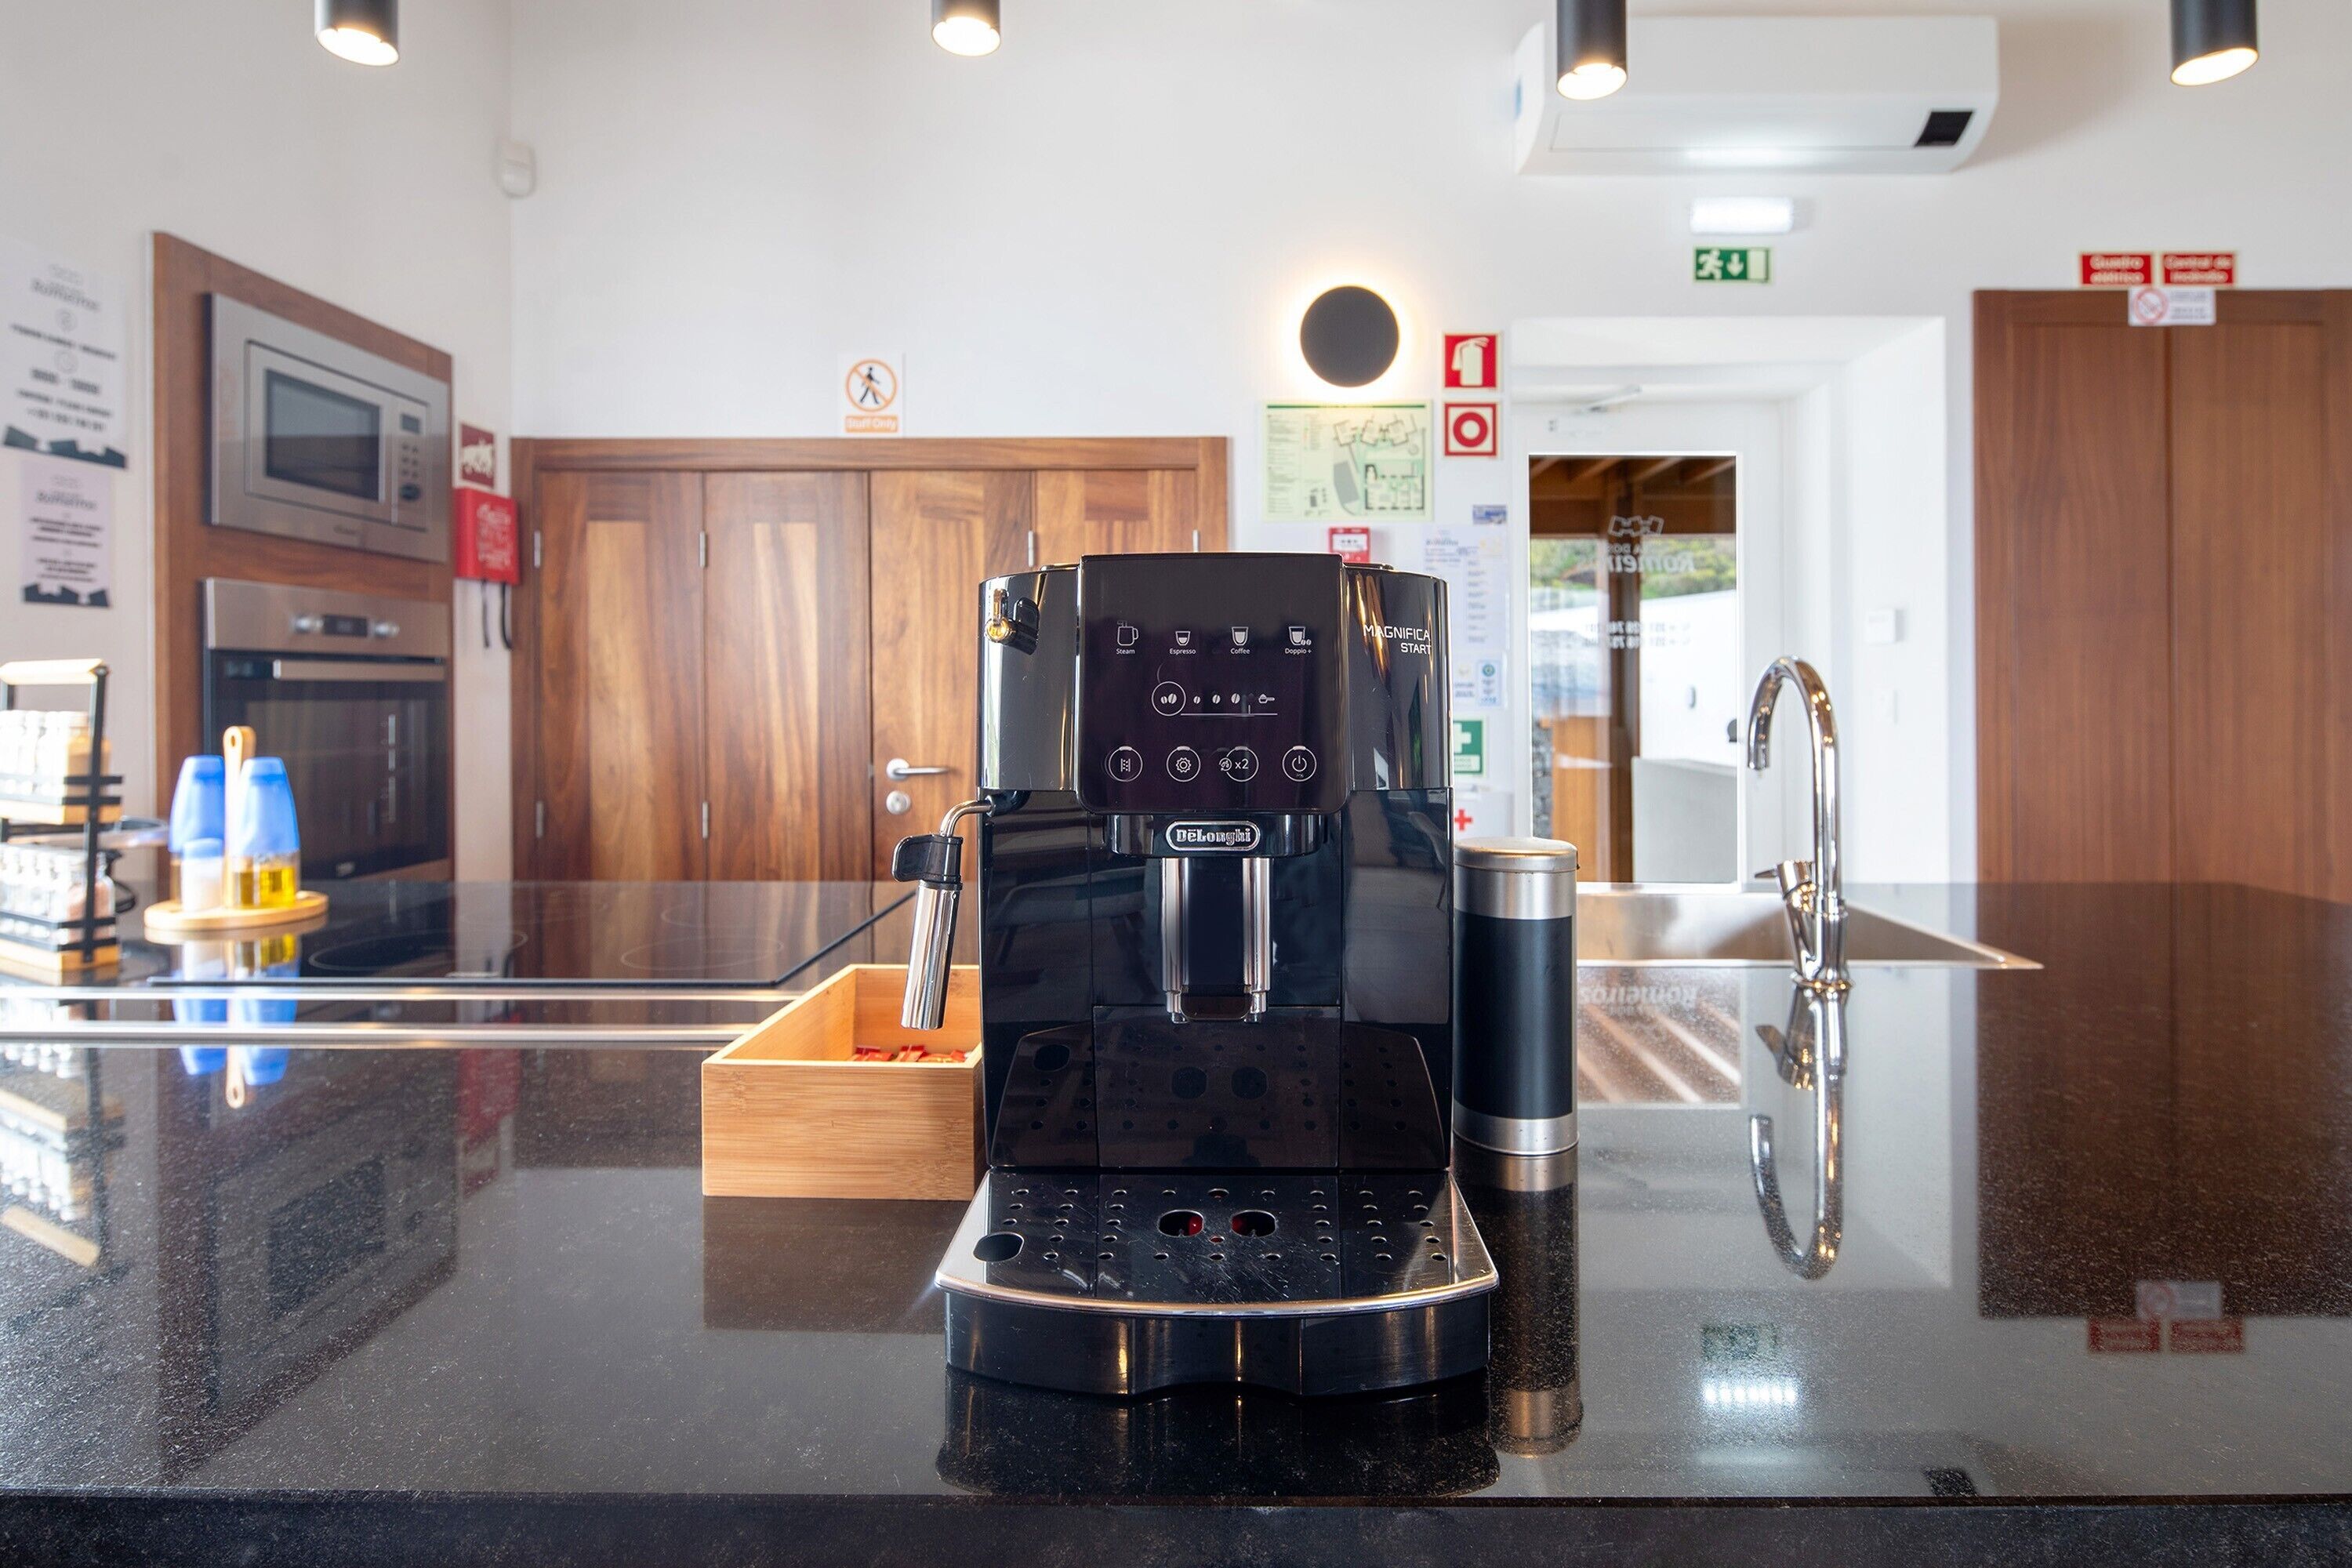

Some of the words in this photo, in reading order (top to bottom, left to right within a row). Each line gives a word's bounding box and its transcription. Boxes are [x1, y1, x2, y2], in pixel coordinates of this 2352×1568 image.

[1363, 624, 1431, 641] MAGNIFICA
[1400, 642, 1432, 655] START
[1235, 758, 1249, 770] x2
